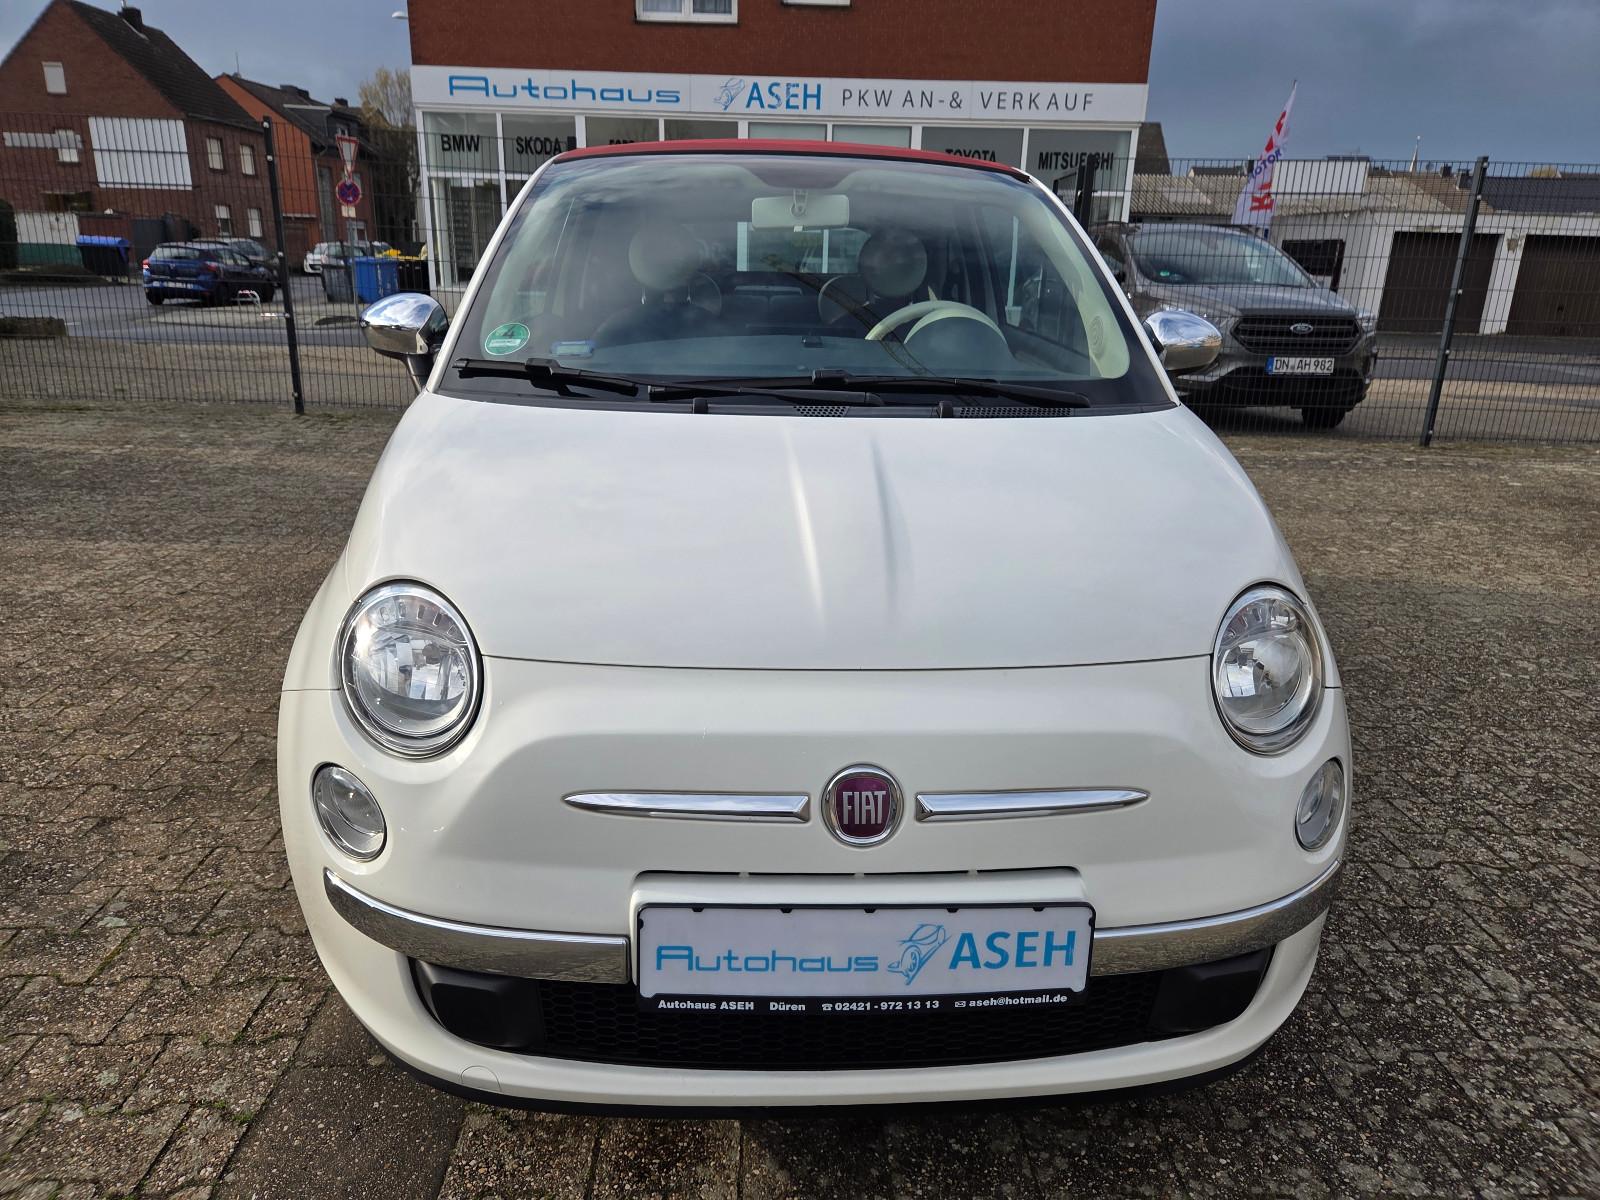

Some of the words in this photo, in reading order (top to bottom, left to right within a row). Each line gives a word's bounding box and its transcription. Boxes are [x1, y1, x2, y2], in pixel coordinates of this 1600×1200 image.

[448, 75, 681, 103] Autohaus
[745, 81, 822, 110] ASEH
[842, 88, 893, 107] PKW
[980, 91, 1094, 111] VERKAUF
[441, 134, 480, 152] BMW
[516, 136, 562, 155] SKODA
[1038, 152, 1113, 170] MITSUBSHI
[842, 790, 886, 825] FIAT
[656, 945, 879, 972] Autohaus
[948, 930, 1076, 970] ASEH
[658, 1000, 716, 1010] Autohaus
[720, 1001, 754, 1010] ASEH
[769, 1001, 806, 1011] Düren
[968, 994, 1068, 1008] aseh@hotmail.de
